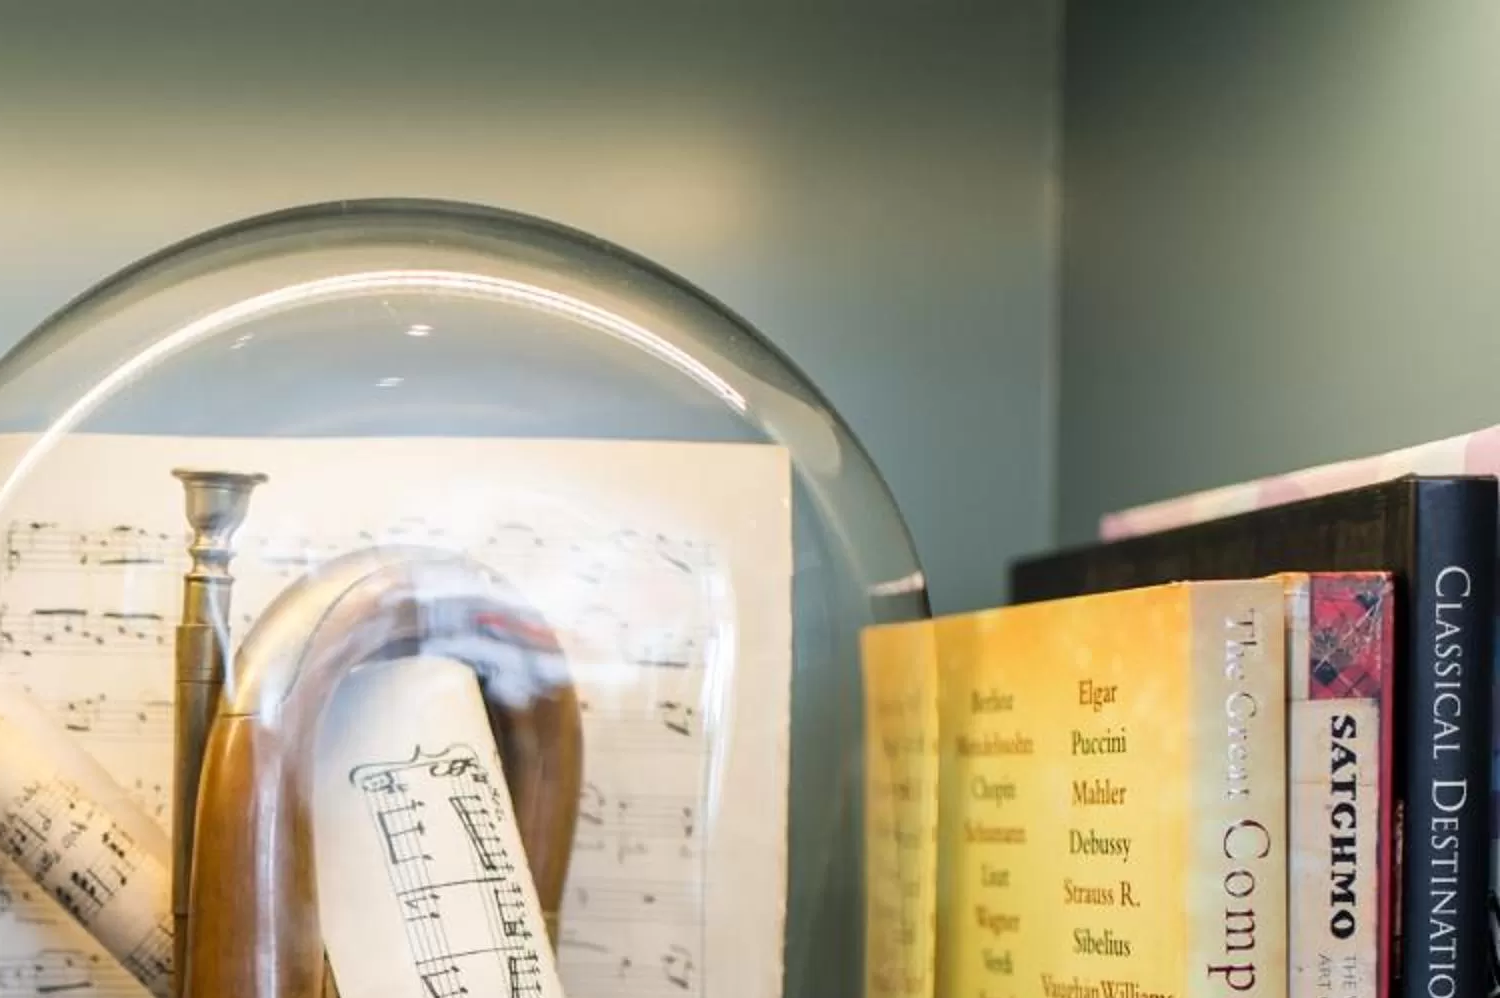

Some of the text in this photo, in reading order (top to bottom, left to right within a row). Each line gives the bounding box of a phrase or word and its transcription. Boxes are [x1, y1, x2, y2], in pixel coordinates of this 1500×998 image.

[1432, 564, 1473, 760] CLASSICAL
[1078, 678, 1118, 713] Elgar
[1071, 727, 1128, 757] Puccini
[1072, 779, 1128, 806] Mahler
[1329, 712, 1358, 941] SATCHMO
[1068, 828, 1132, 863] Debussy
[1063, 878, 1141, 908] Strauss R.
[1072, 926, 1132, 958] Sibelius
[1316, 952, 1332, 991] ART
[1342, 953, 1358, 991] THE
